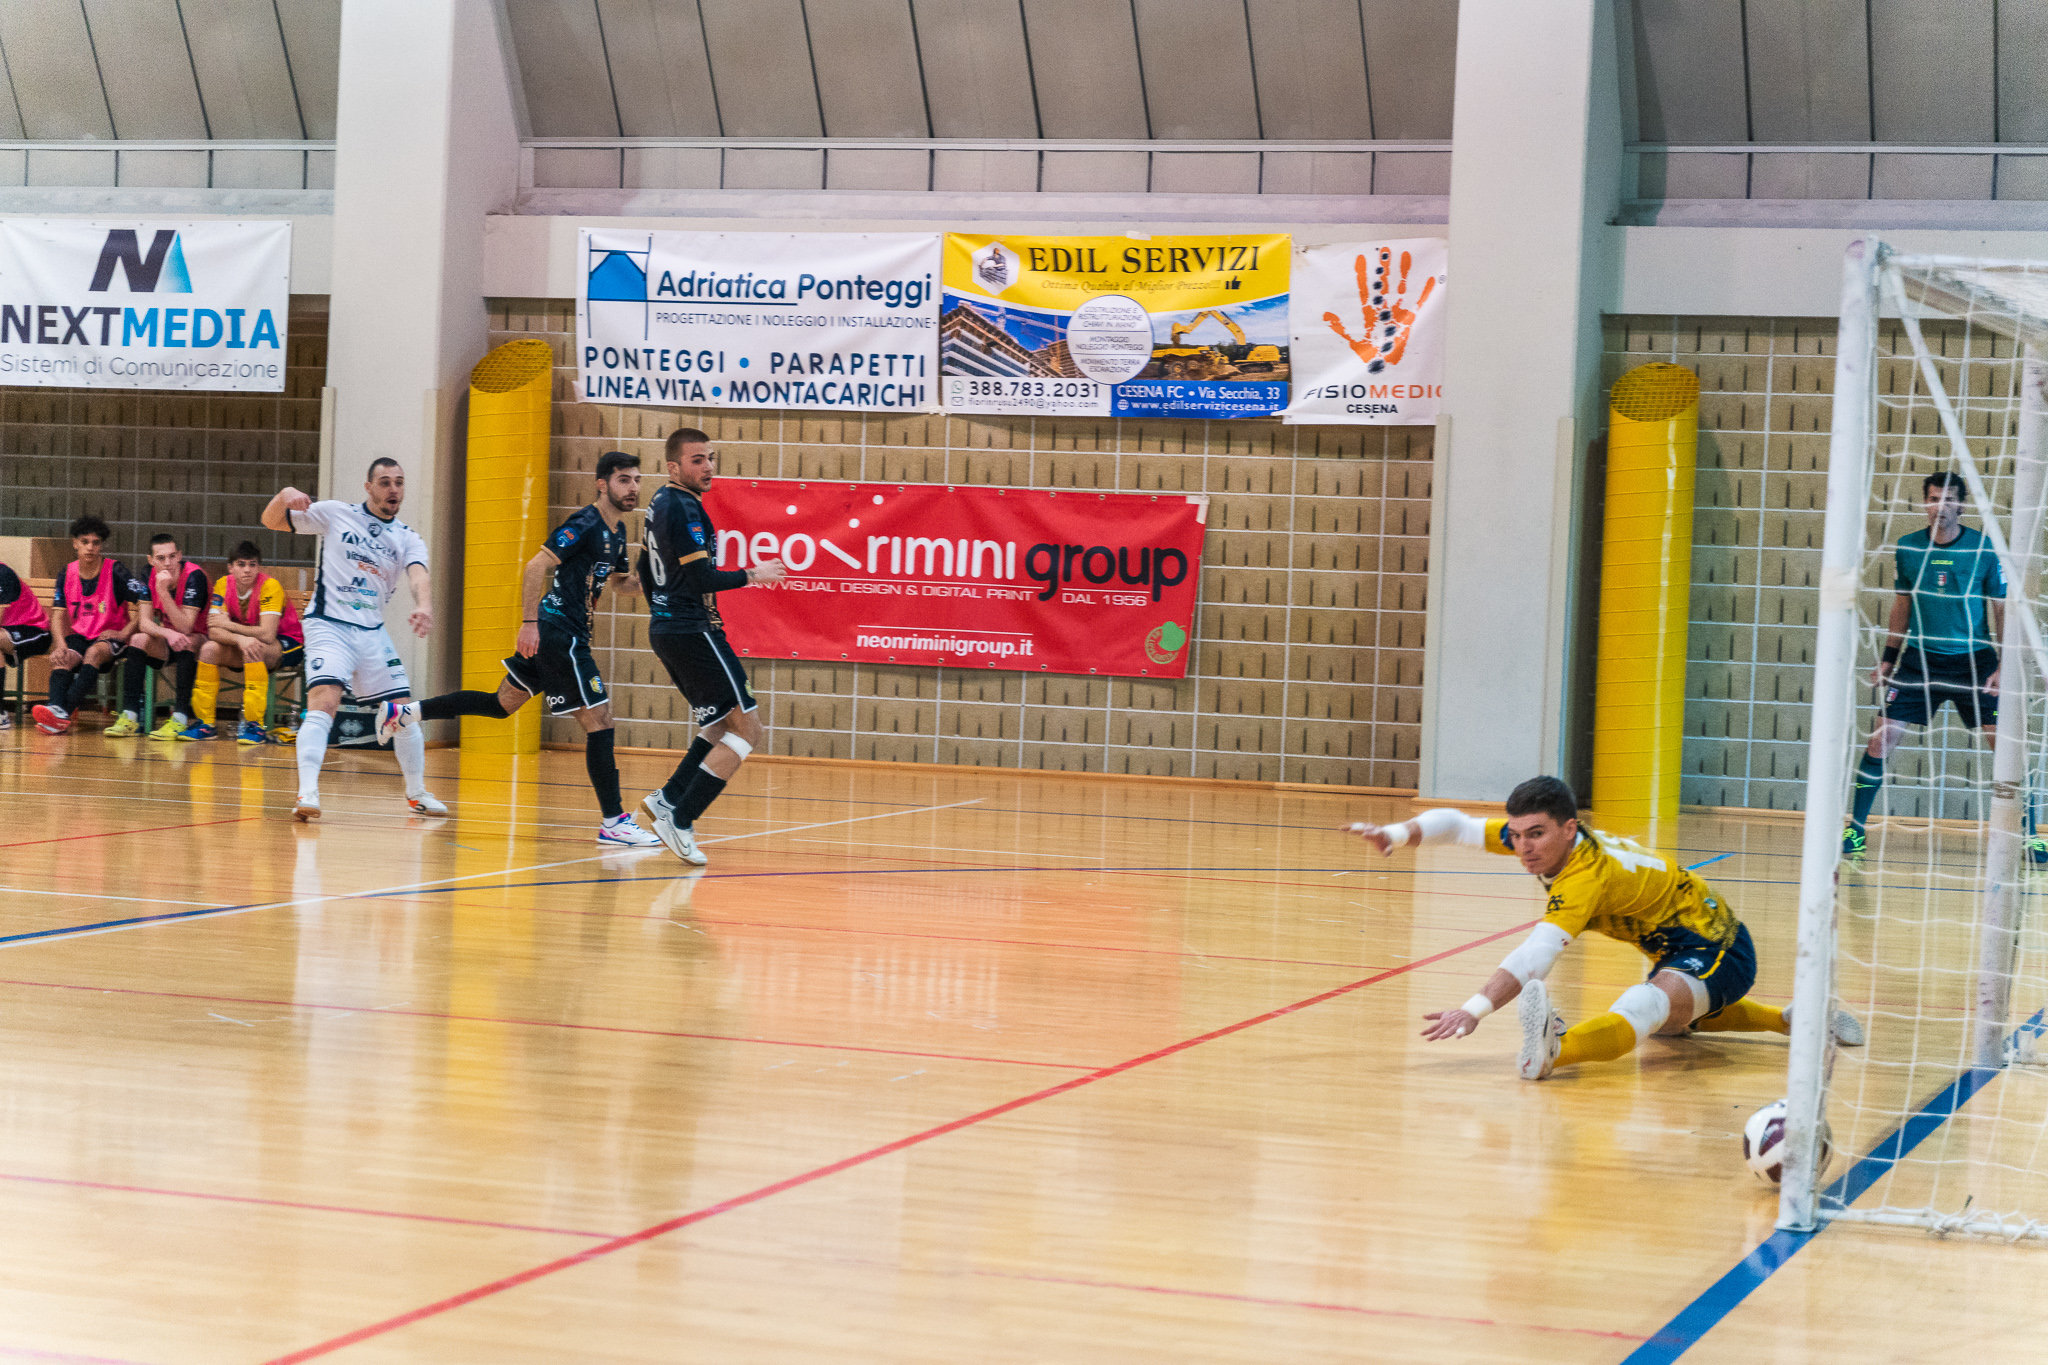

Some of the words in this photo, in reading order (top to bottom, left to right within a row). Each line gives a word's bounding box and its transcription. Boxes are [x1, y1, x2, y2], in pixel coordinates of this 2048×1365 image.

[1028, 247, 1108, 272] EDIL
[1121, 246, 1260, 274] SERVIZI
[656, 270, 787, 299] Adriatica
[797, 273, 933, 308] Ponteggi
[1, 304, 280, 349] NEXTMEDIA
[656, 312, 752, 326] PROGETTAZIONE
[762, 315, 827, 327] NOLEGGIO
[837, 316, 931, 329] INSTALLAZIONE
[1, 353, 78, 374] Sistemi
[84, 357, 103, 375] di
[109, 357, 279, 379] Comunicazione
[585, 346, 725, 373] PONTEGGI
[770, 352, 925, 377] PARAPETTI
[586, 376, 650, 399] LINEA
[655, 378, 706, 401] VITA
[729, 380, 925, 407] MONTACARICHI
[969, 381, 1099, 398] 388.783.2031
[1116, 384, 1164, 398] CESENA
[1166, 385, 1184, 398] FC
[1198, 386, 1217, 399] Via
[1219, 387, 1263, 401] Secchia,
[1266, 387, 1281, 399] 33
[1131, 400, 1279, 411] www.edilservizicesena.it
[1346, 404, 1398, 414] CESENA
[867, 535, 1016, 579] rimini
[1025, 543, 1188, 602] group
[840, 582, 901, 595] DESIGN
[905, 585, 918, 596] &
[922, 585, 983, 598] DIGITAL
[986, 588, 1034, 601] PRINT
[1062, 592, 1096, 605] DAL
[1102, 594, 1148, 606] 1956
[71, 601, 81, 619] 7
[856, 634, 1034, 658] neonriminigroup.it
